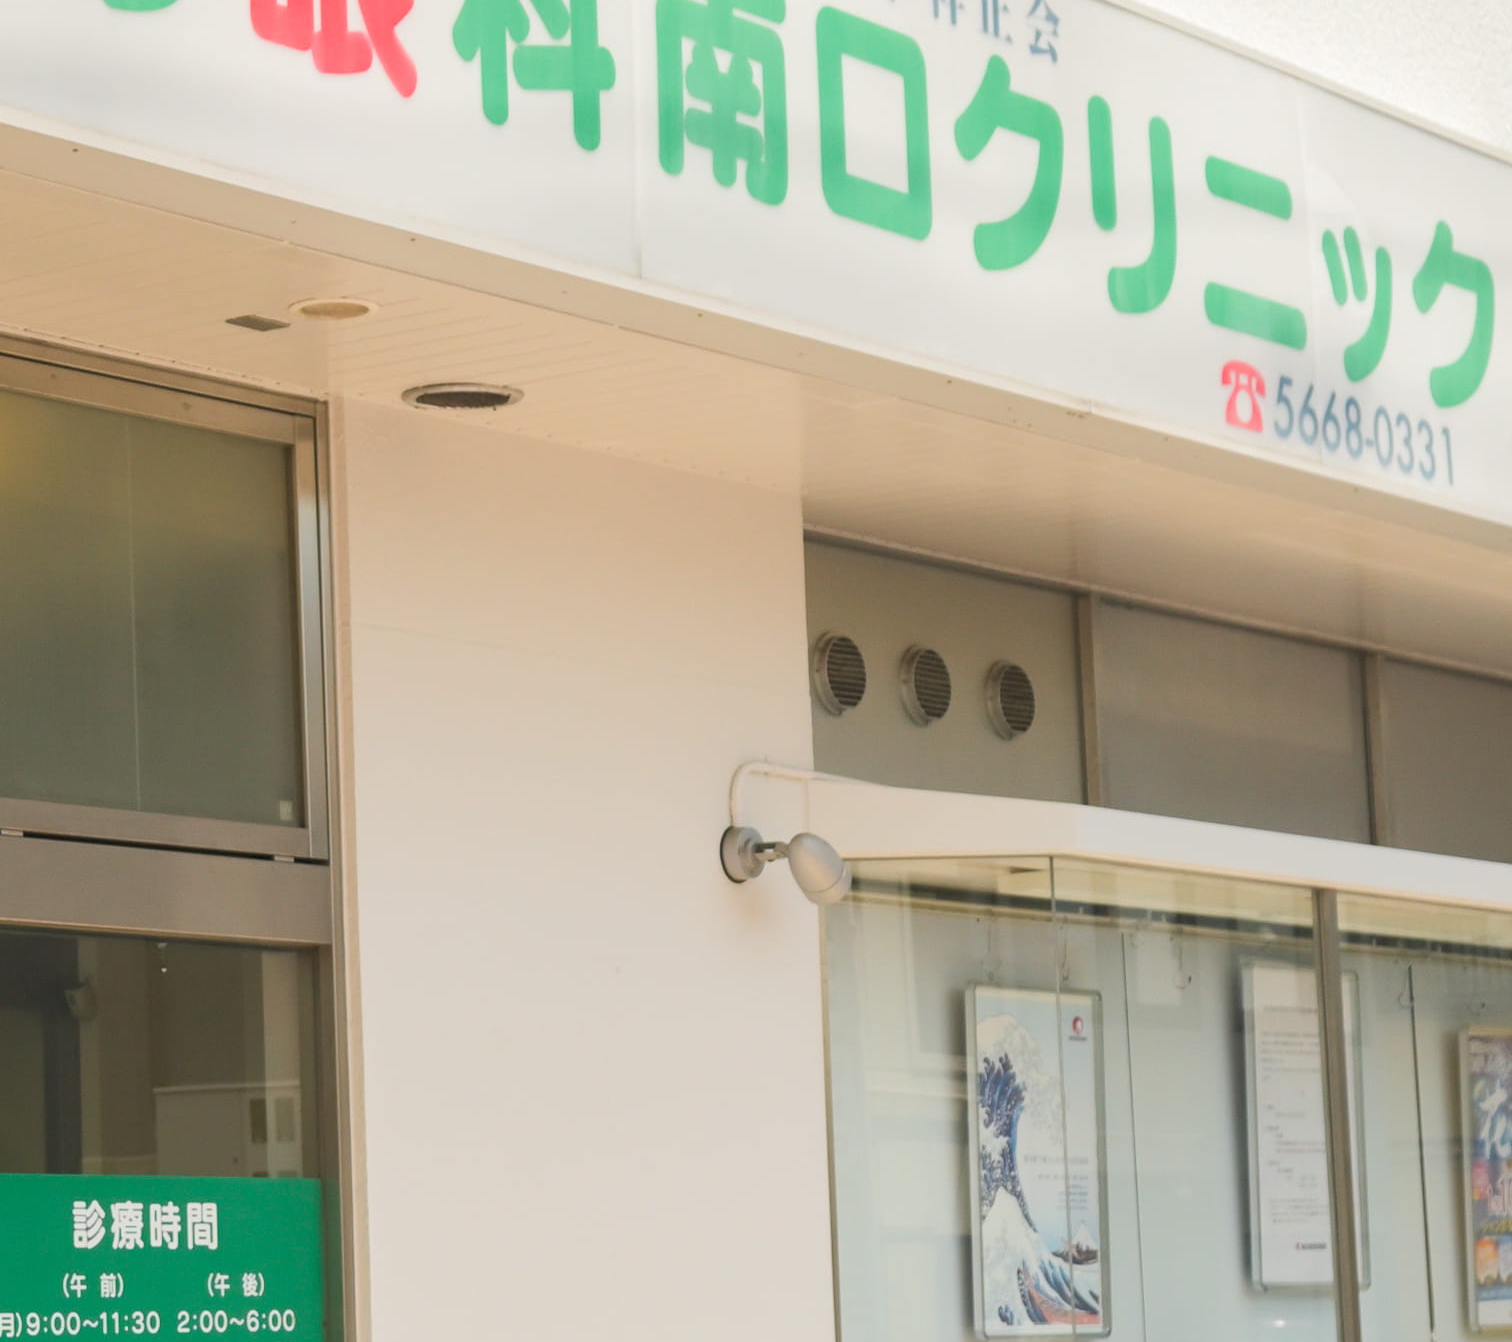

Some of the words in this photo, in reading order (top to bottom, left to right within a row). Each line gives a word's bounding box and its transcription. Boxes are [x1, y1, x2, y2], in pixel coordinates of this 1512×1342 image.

[1273, 374, 1454, 487] 5668-0331
[72, 1200, 219, 1250] 診療時間
